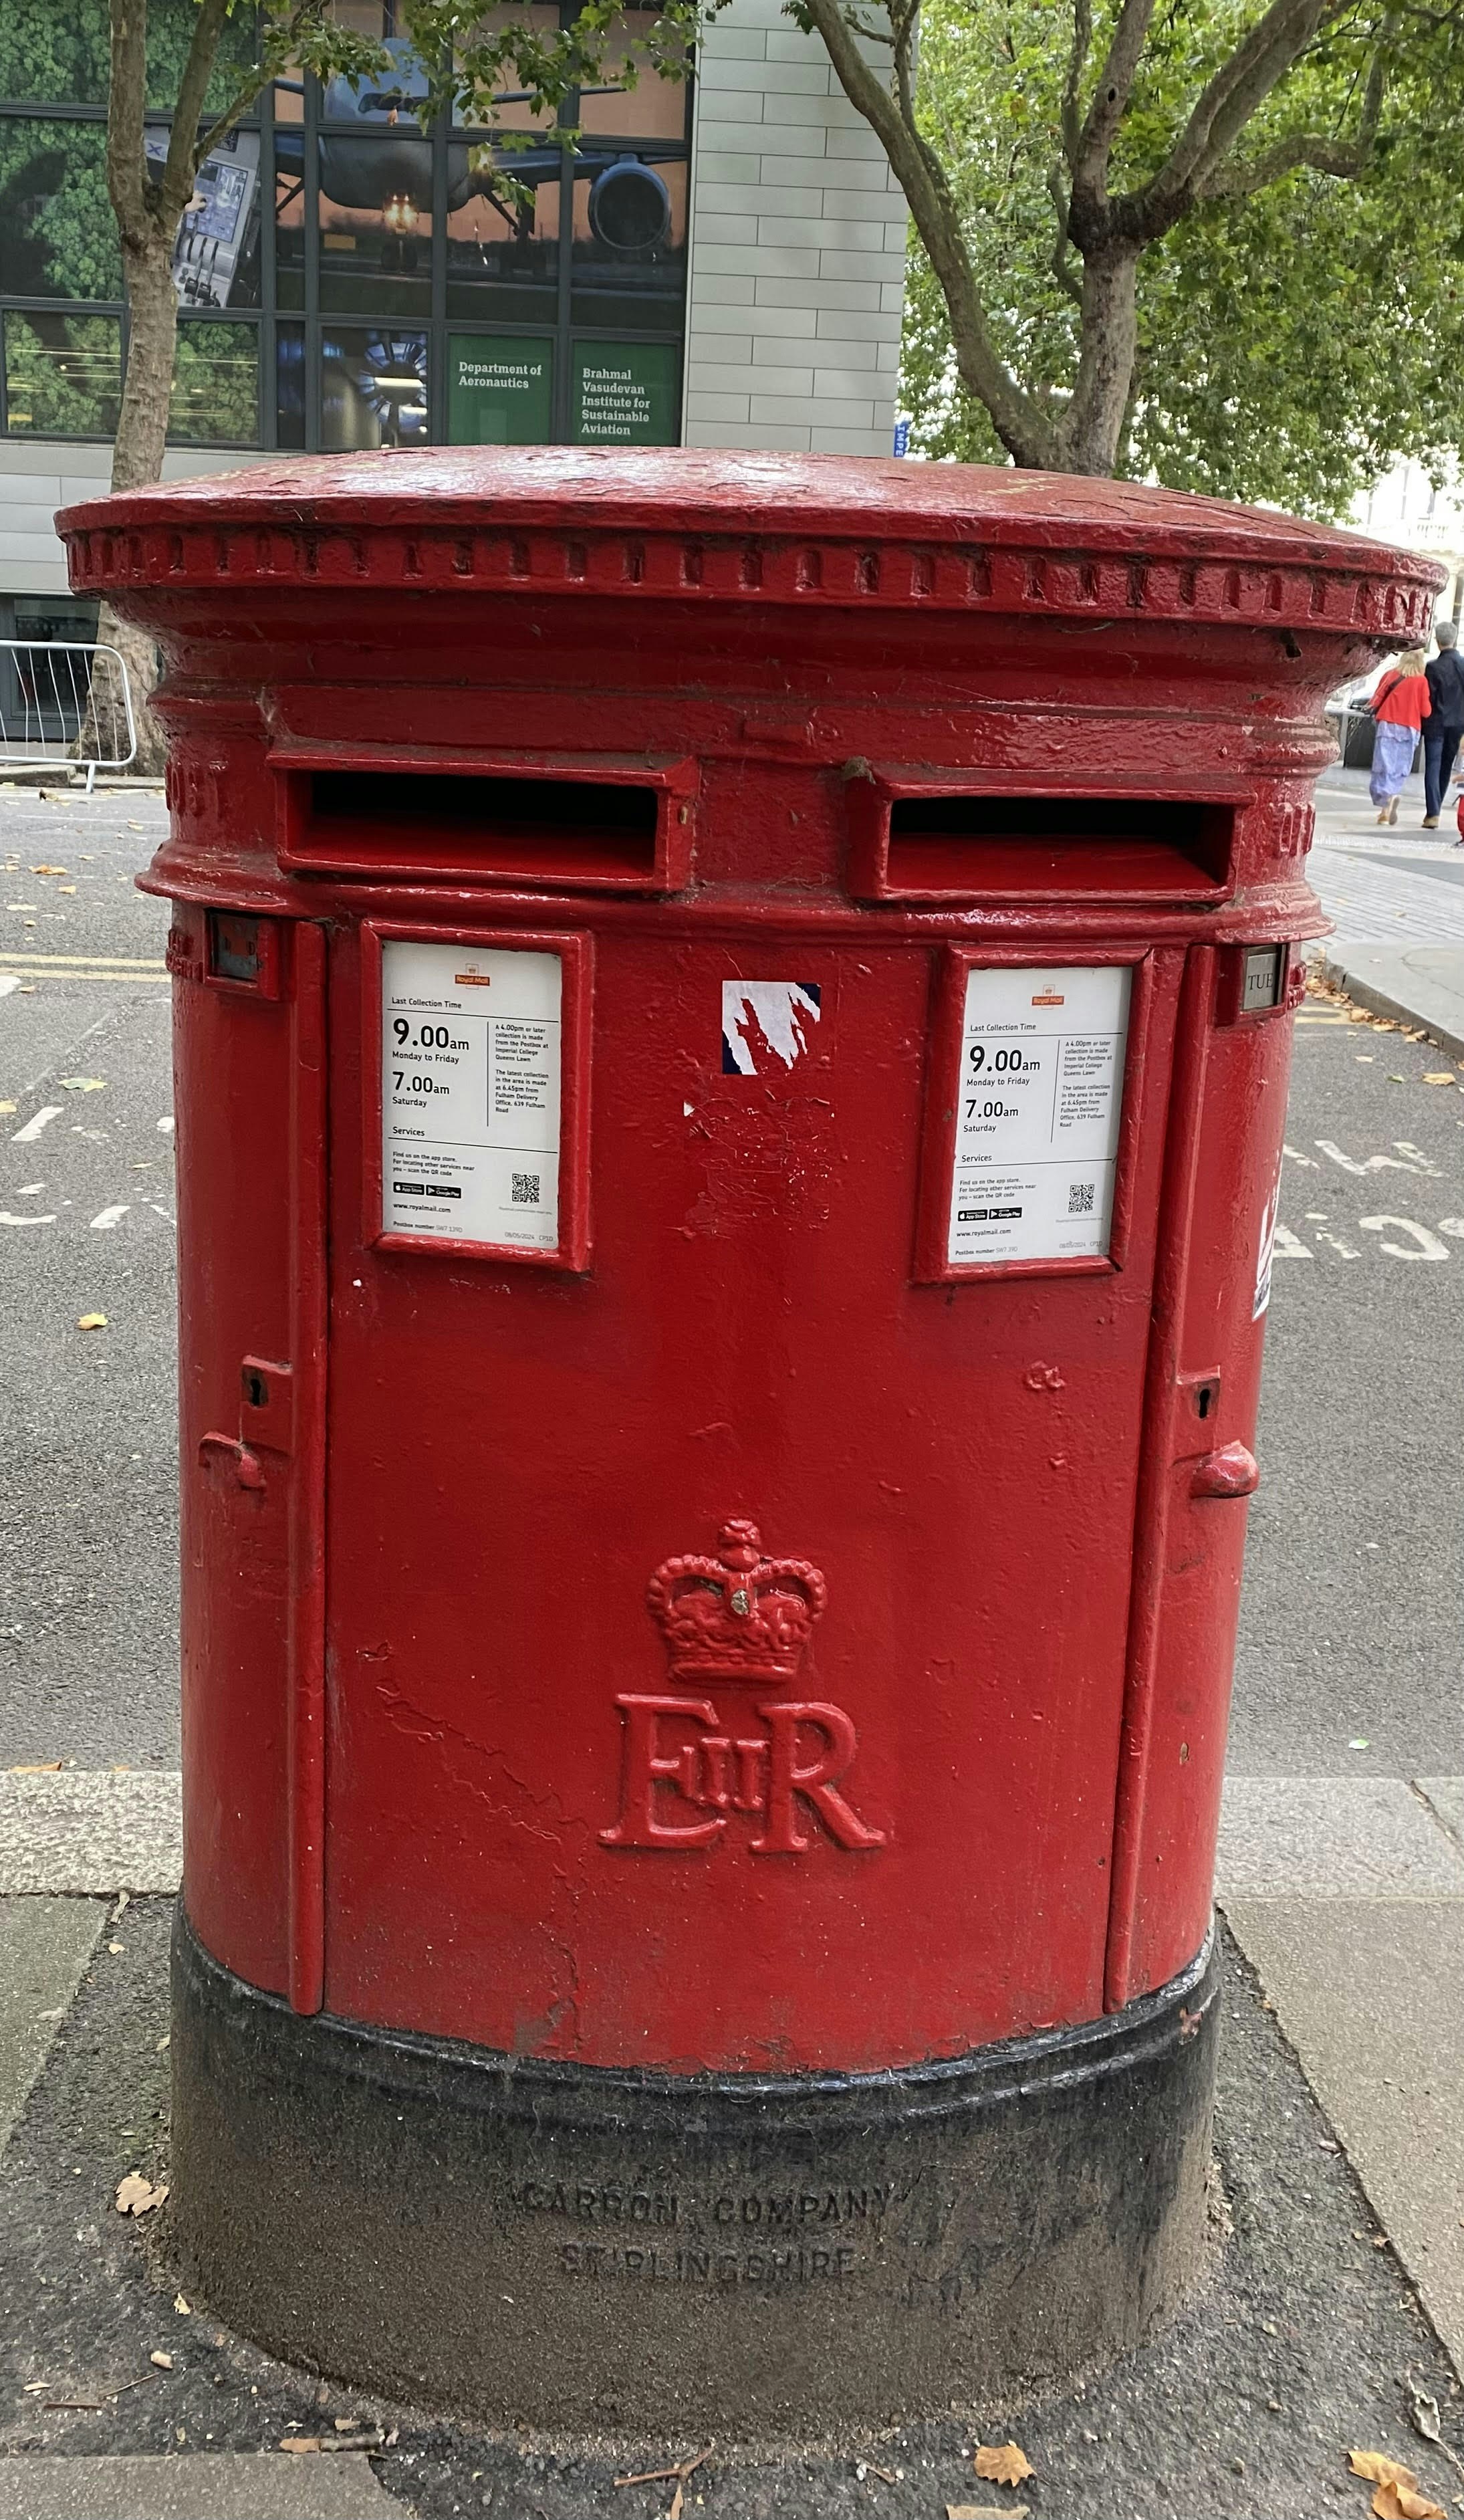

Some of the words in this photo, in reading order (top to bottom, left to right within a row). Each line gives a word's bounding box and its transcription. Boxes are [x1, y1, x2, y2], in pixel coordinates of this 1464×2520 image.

[459, 361, 528, 374] Department
[530, 364, 542, 376] of
[582, 368, 632, 380] Brahmal
[459, 376, 529, 388] Aeronautics
[582, 382, 645, 394] Vasudevan
[582, 396, 632, 408] Institute
[633, 398, 650, 409] for
[582, 409, 650, 422] Sustainable
[581, 423, 631, 435] Aviation
[457, 976, 473, 985] Royal
[475, 977, 489, 985] Mail
[1248, 973, 1273, 990] TUE
[408, 998, 443, 1007] Collection
[444, 1000, 462, 1008] Time
[1033, 997, 1050, 1005] Royal
[393, 1018, 469, 1050] 9.00am
[986, 1024, 1018, 1032] Collection
[392, 1051, 422, 1062] Monday
[435, 1054, 459, 1064] Friday
[519, 1048, 538, 1056] College
[970, 1045, 1040, 1072] 9.00am
[392, 1071, 450, 1095] 7.00am
[967, 1078, 995, 1087] Monday
[1007, 1077, 1030, 1086] Friday
[502, 1084, 524, 1093] 6.45pm
[392, 1097, 427, 1108] Saturday
[965, 1099, 1019, 1118] 7.00am
[392, 1126, 425, 1136] Services
[963, 1124, 996, 1133] Saturday
[402, 1159, 423, 1167] locating
[961, 1154, 992, 1163] Services
[393, 1204, 451, 1213] www.royalmail.com
[957, 1228, 1011, 1237] www.royalmail.com
[521, 2181, 681, 2226] CARRON
[713, 2182, 892, 2224] COMPANY
[561, 2243, 856, 2283] STIRLINGSHIRE
